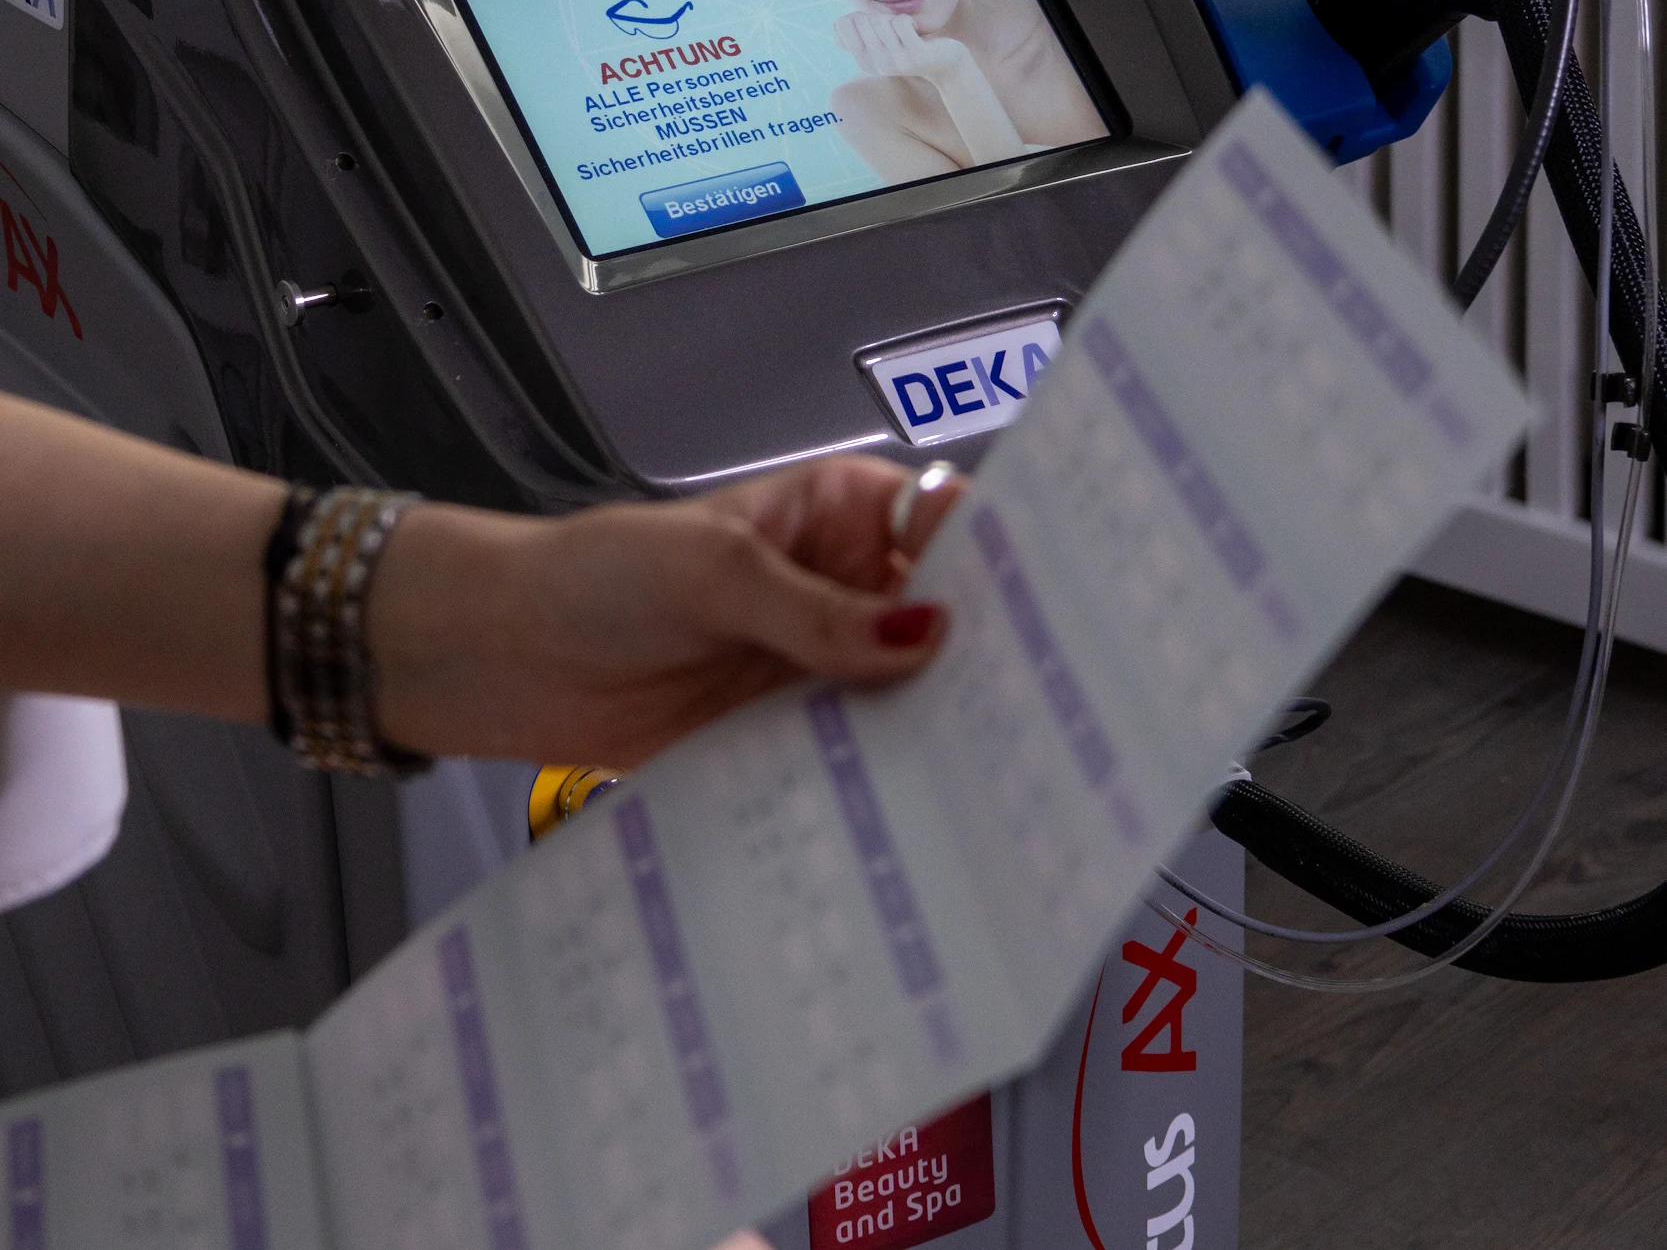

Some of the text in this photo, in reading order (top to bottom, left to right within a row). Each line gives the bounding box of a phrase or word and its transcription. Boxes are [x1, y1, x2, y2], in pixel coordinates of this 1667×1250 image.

[584, 59, 779, 113] ALLE Personen im
[600, 36, 742, 85] ACHTUNG
[591, 77, 791, 133] Sicherheitsbereich
[655, 106, 748, 141] MÜSSEN
[577, 111, 844, 181] Sicherheitsbrillen tragen.
[665, 180, 782, 219] Bestätigen
[0, 198, 83, 341] AX
[891, 342, 1050, 427] DEKA
[1121, 907, 1197, 1072] AX
[834, 1153, 948, 1210] Beauty
[836, 1184, 961, 1243] and Spa
